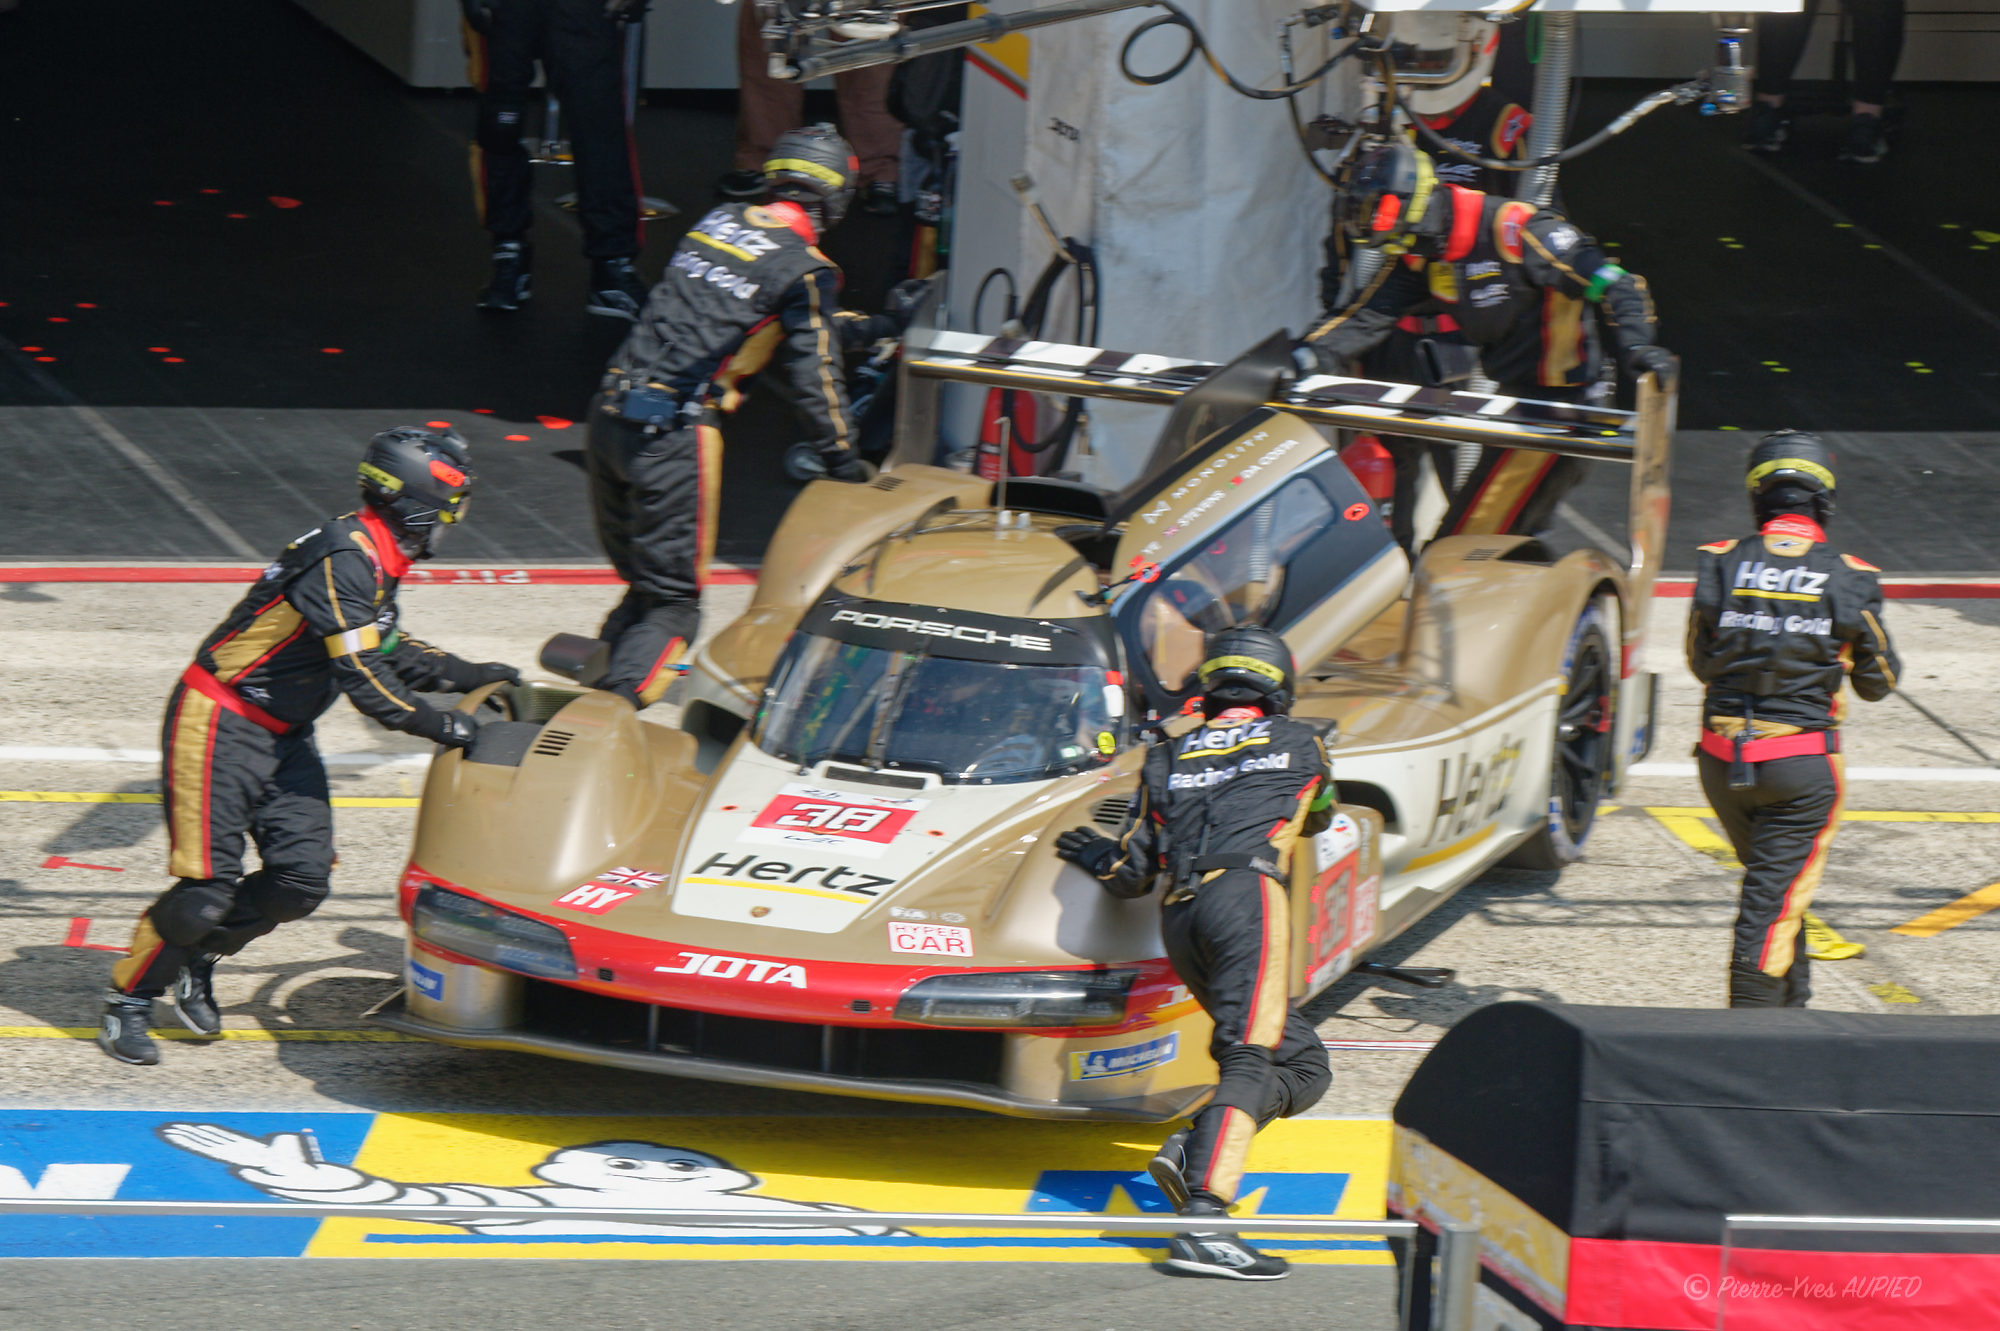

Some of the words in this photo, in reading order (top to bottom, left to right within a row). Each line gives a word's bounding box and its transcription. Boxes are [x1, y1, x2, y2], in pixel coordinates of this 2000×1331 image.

[692, 210, 781, 256] Hertz
[1171, 431, 1269, 499] MONOLITH
[1177, 489, 1226, 527] STEVENS
[1240, 465, 1262, 479] DA
[1258, 439, 1299, 466] COSTA
[451, 570, 532, 584] PIT
[1734, 561, 1830, 594] Hertz
[830, 609, 1051, 651] PORSCHE
[1719, 611, 1783, 635] Racing
[1784, 615, 1833, 635] Gold
[1180, 721, 1272, 753] Hertz
[1168, 765, 1238, 790] Racing
[1239, 752, 1290, 771] Gold
[775, 803, 892, 832] 38
[693, 852, 896, 896] Hertz
[558, 885, 633, 908] HY
[896, 925, 962, 937] HYPER
[897, 934, 965, 953] CAR
[654, 952, 807, 989] JOTA
